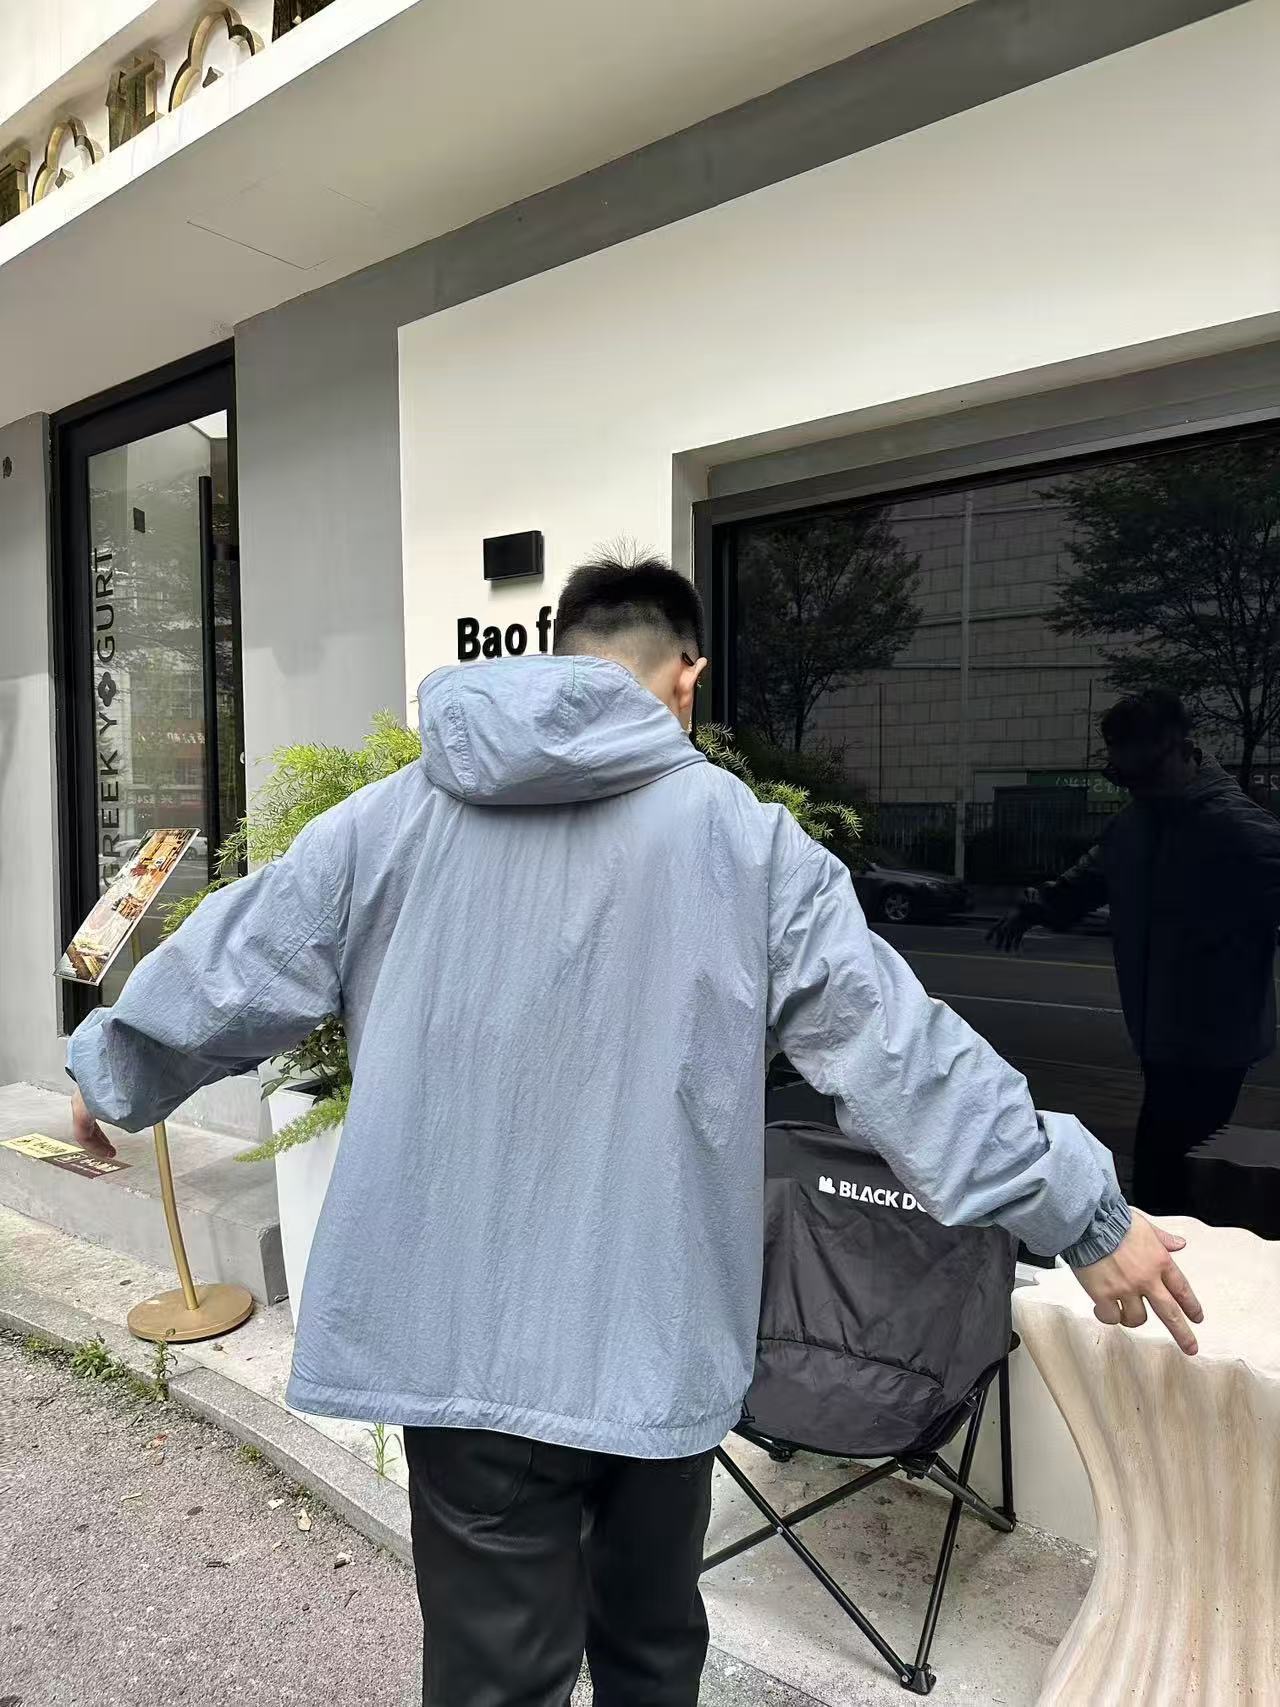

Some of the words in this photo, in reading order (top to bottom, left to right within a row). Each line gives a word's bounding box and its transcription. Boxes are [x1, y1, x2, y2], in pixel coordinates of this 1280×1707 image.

[457, 617, 527, 660] Bao
[536, 606, 557, 655] f
[839, 1180, 899, 1208] BLACK
